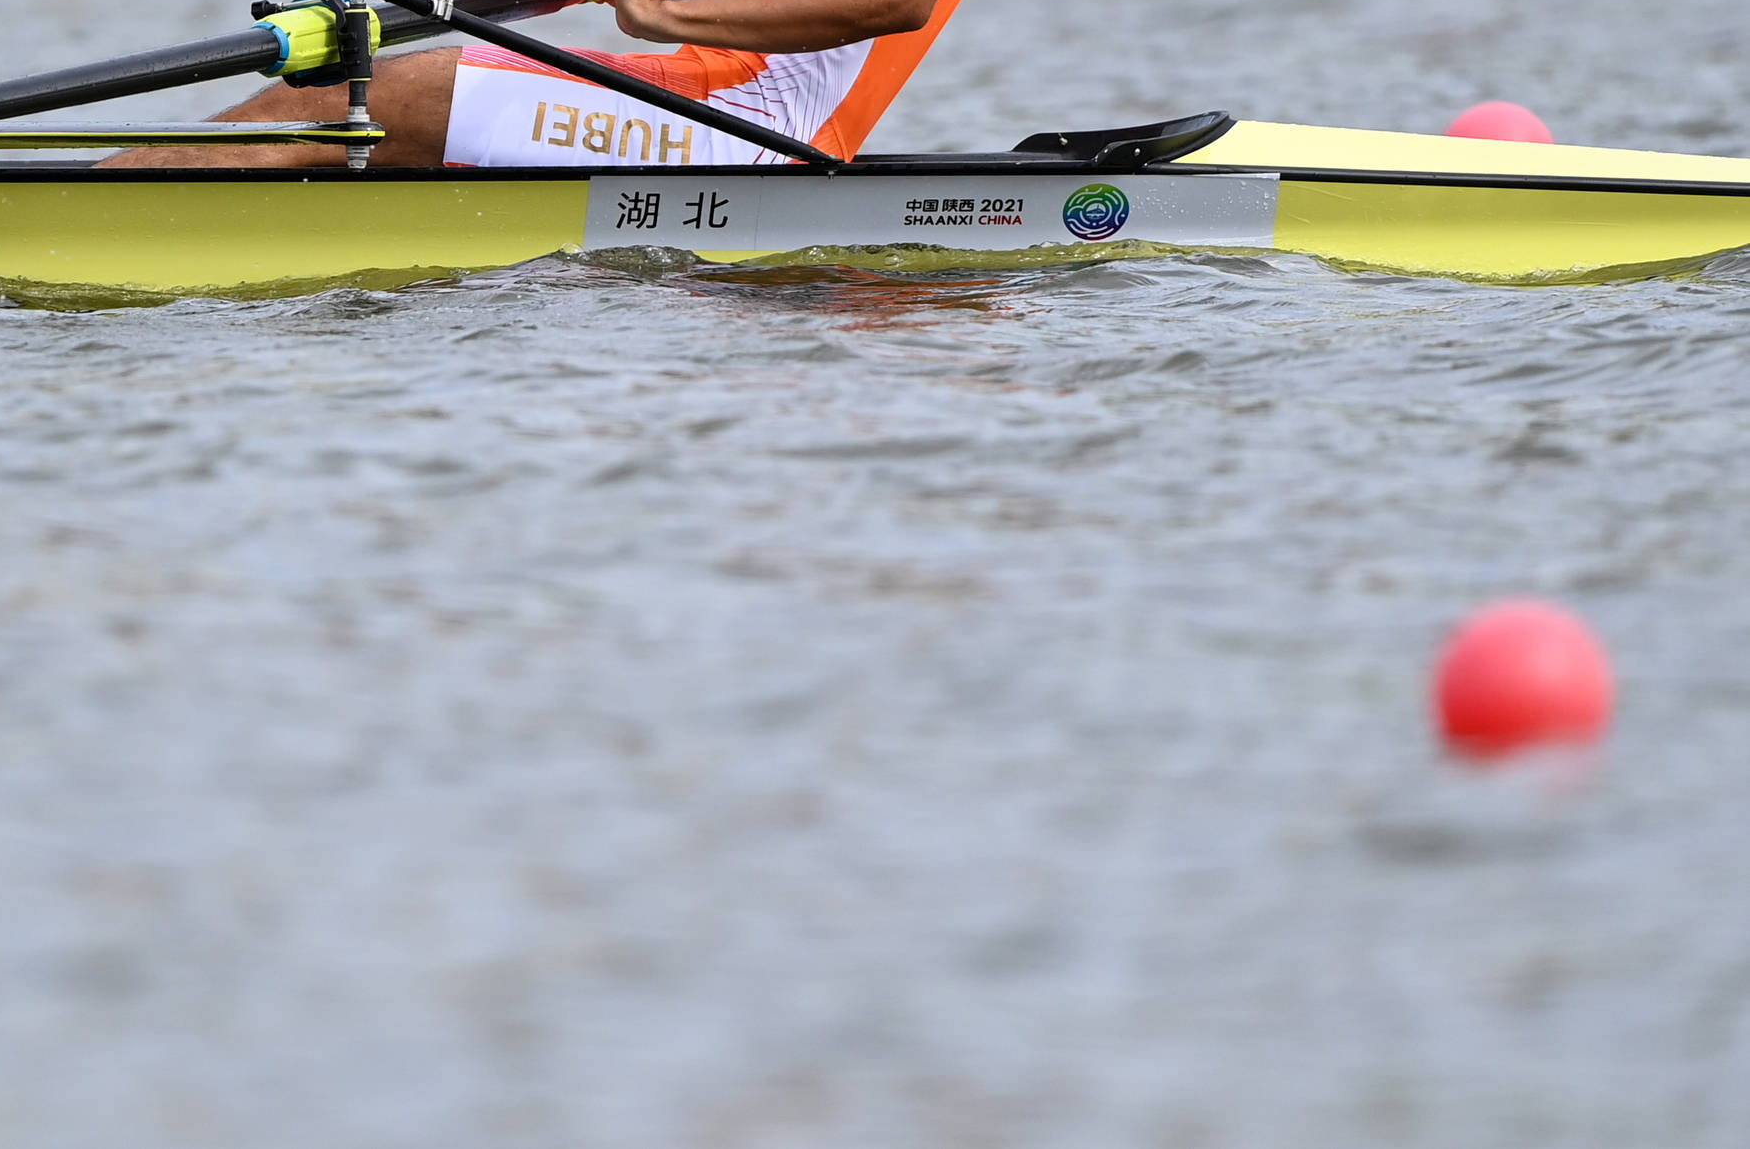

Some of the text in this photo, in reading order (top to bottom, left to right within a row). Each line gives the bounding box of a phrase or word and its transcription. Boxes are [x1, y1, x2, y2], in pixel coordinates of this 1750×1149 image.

[531, 102, 693, 164] HUBEI
[616, 191, 729, 229] 湖北
[979, 198, 1024, 212] 2021
[904, 215, 1022, 226] SHAANXI CHINA
